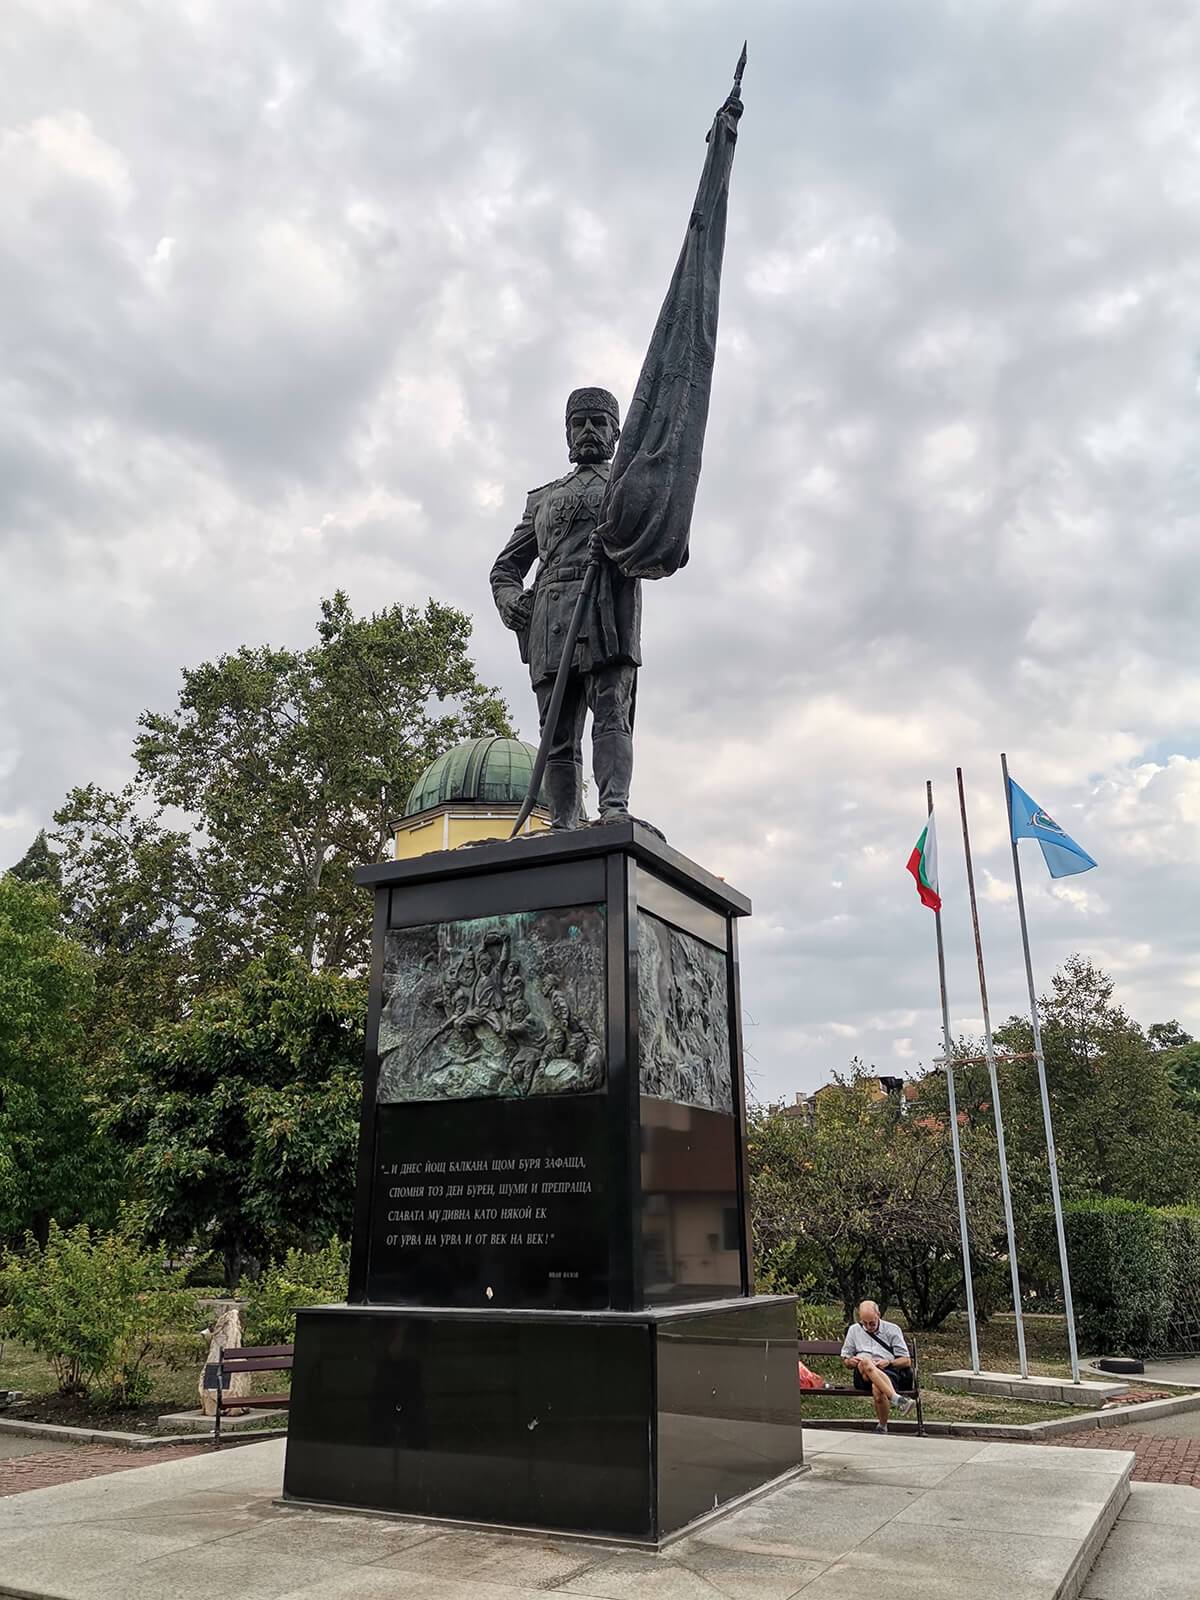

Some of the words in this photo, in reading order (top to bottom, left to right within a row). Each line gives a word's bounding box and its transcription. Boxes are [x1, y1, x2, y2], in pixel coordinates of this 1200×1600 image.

[400, 1162, 423, 1175] ДНЕС
[424, 1160, 447, 1174] ЙОЩ
[449, 1160, 488, 1172] БАЛКАНА
[491, 1159, 515, 1172] ЩОМ
[518, 1158, 541, 1172] БУРЯ
[389, 1186, 425, 1198] СПОМНЯ
[427, 1185, 444, 1197] ТОЗ
[445, 1185, 464, 1198] ДЕН
[498, 1183, 529, 1197] ШУМИ
[531, 1182, 538, 1194] И
[541, 1181, 592, 1194] ПРЕПРАЩА
[387, 1209, 425, 1221] СЛАВАТА
[474, 1208, 498, 1220] КАТО
[500, 1205, 532, 1219] НЯКОЙ
[535, 1207, 548, 1219] ЕК
[386, 1234, 399, 1246] ОТ
[400, 1234, 421, 1248] УРВА
[424, 1233, 437, 1245] НА
[440, 1233, 461, 1247] УРВА
[465, 1233, 472, 1245] И
[475, 1233, 488, 1245] ОТ
[490, 1233, 508, 1245] ВЕК
[510, 1233, 523, 1245] НА
